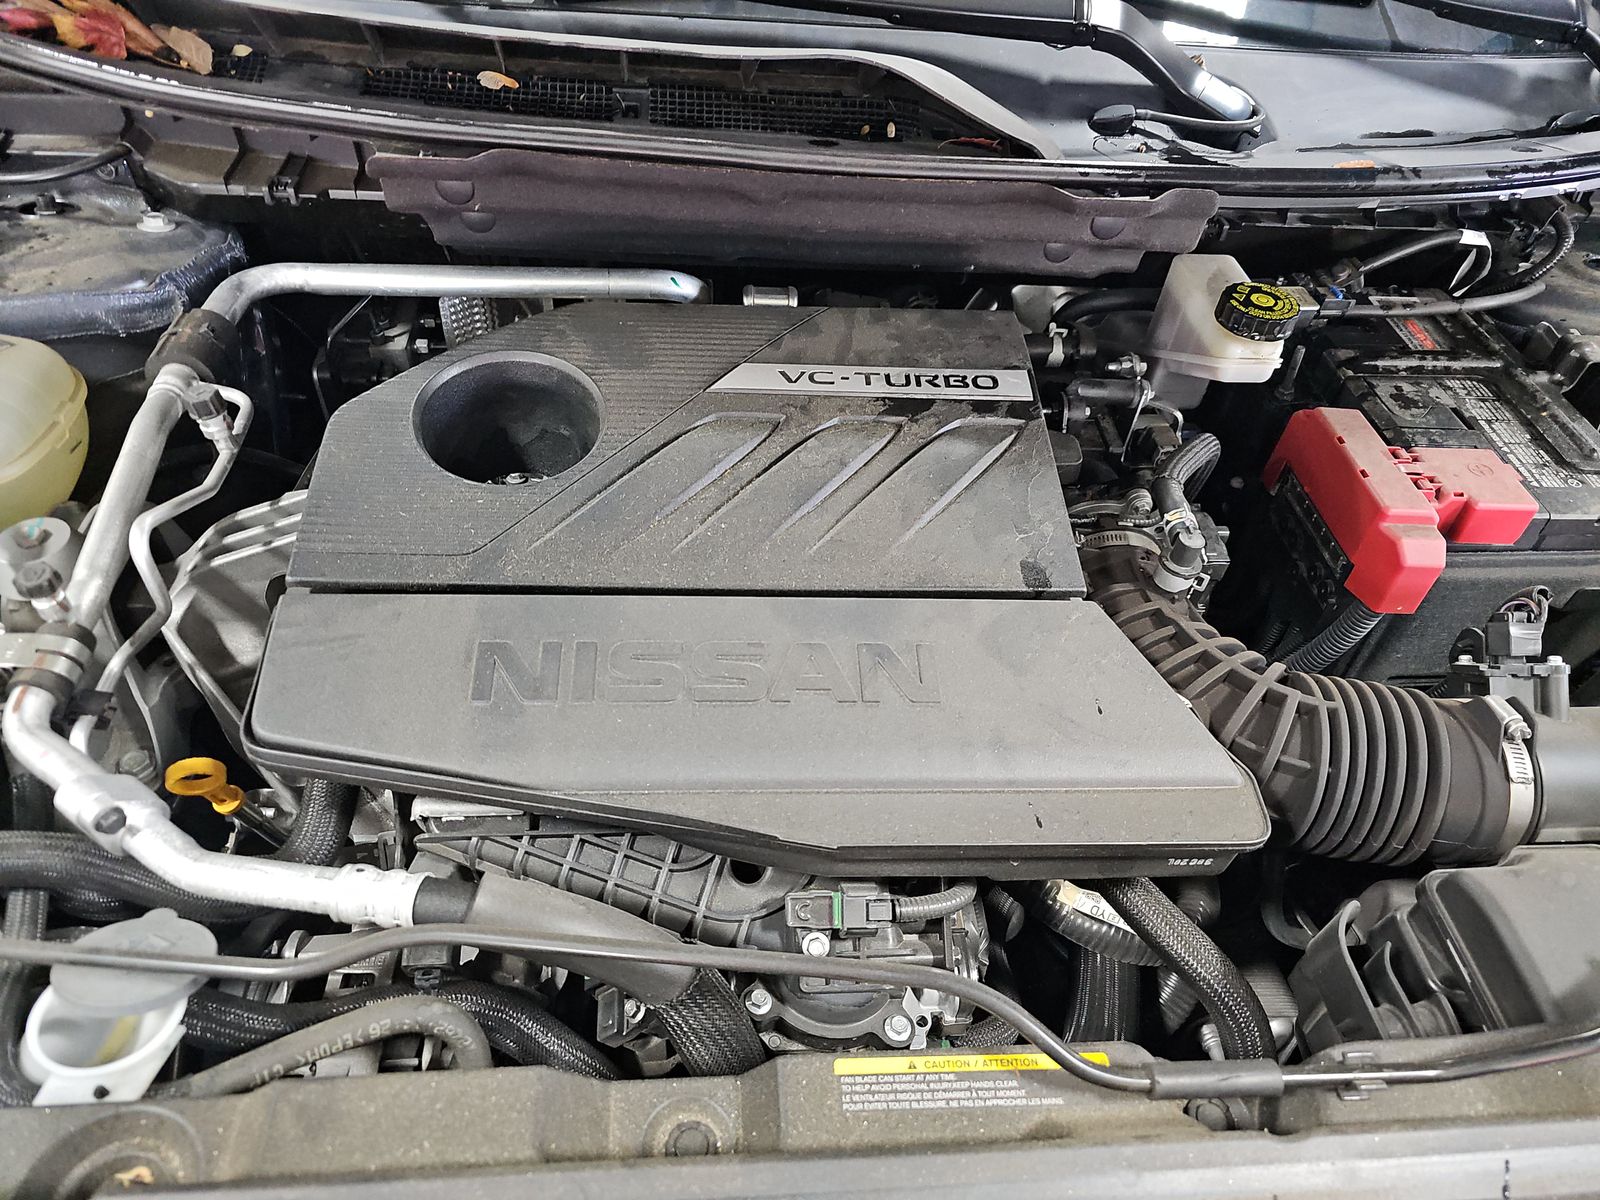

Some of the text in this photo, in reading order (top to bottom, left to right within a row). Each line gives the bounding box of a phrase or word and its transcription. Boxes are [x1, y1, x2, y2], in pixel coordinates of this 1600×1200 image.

[777, 369, 999, 390] VC-TURBO
[469, 639, 942, 705] NISSAN
[924, 1060, 970, 1069] CAUTION
[982, 1058, 1039, 1067] ATTENTION
[852, 1093, 895, 1101] VENTILATEUR
[985, 1098, 1027, 1106] APPROCHER
